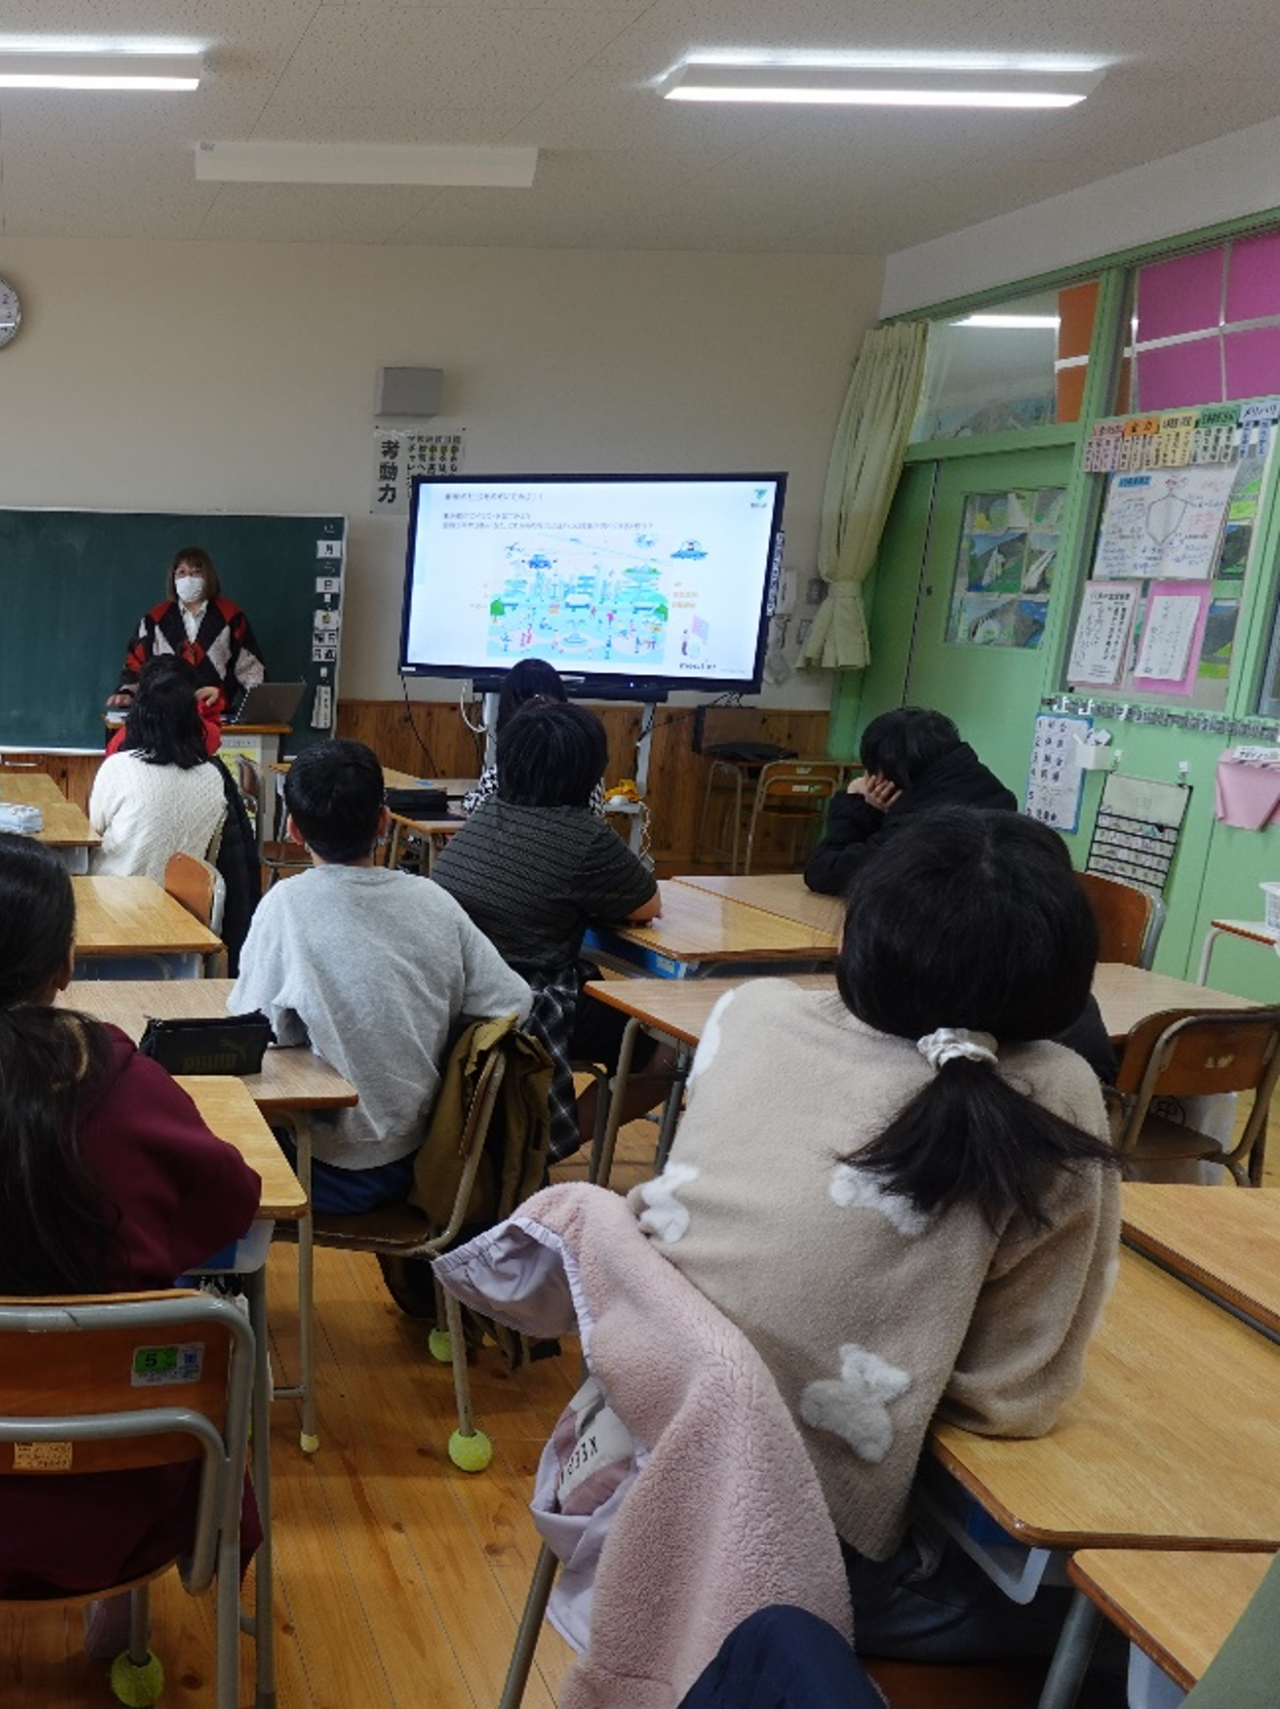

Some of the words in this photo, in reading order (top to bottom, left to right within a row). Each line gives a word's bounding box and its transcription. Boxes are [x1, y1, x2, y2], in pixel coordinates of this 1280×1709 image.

[377, 439, 400, 504] 考動力
[144, 1352, 158, 1368] 5
